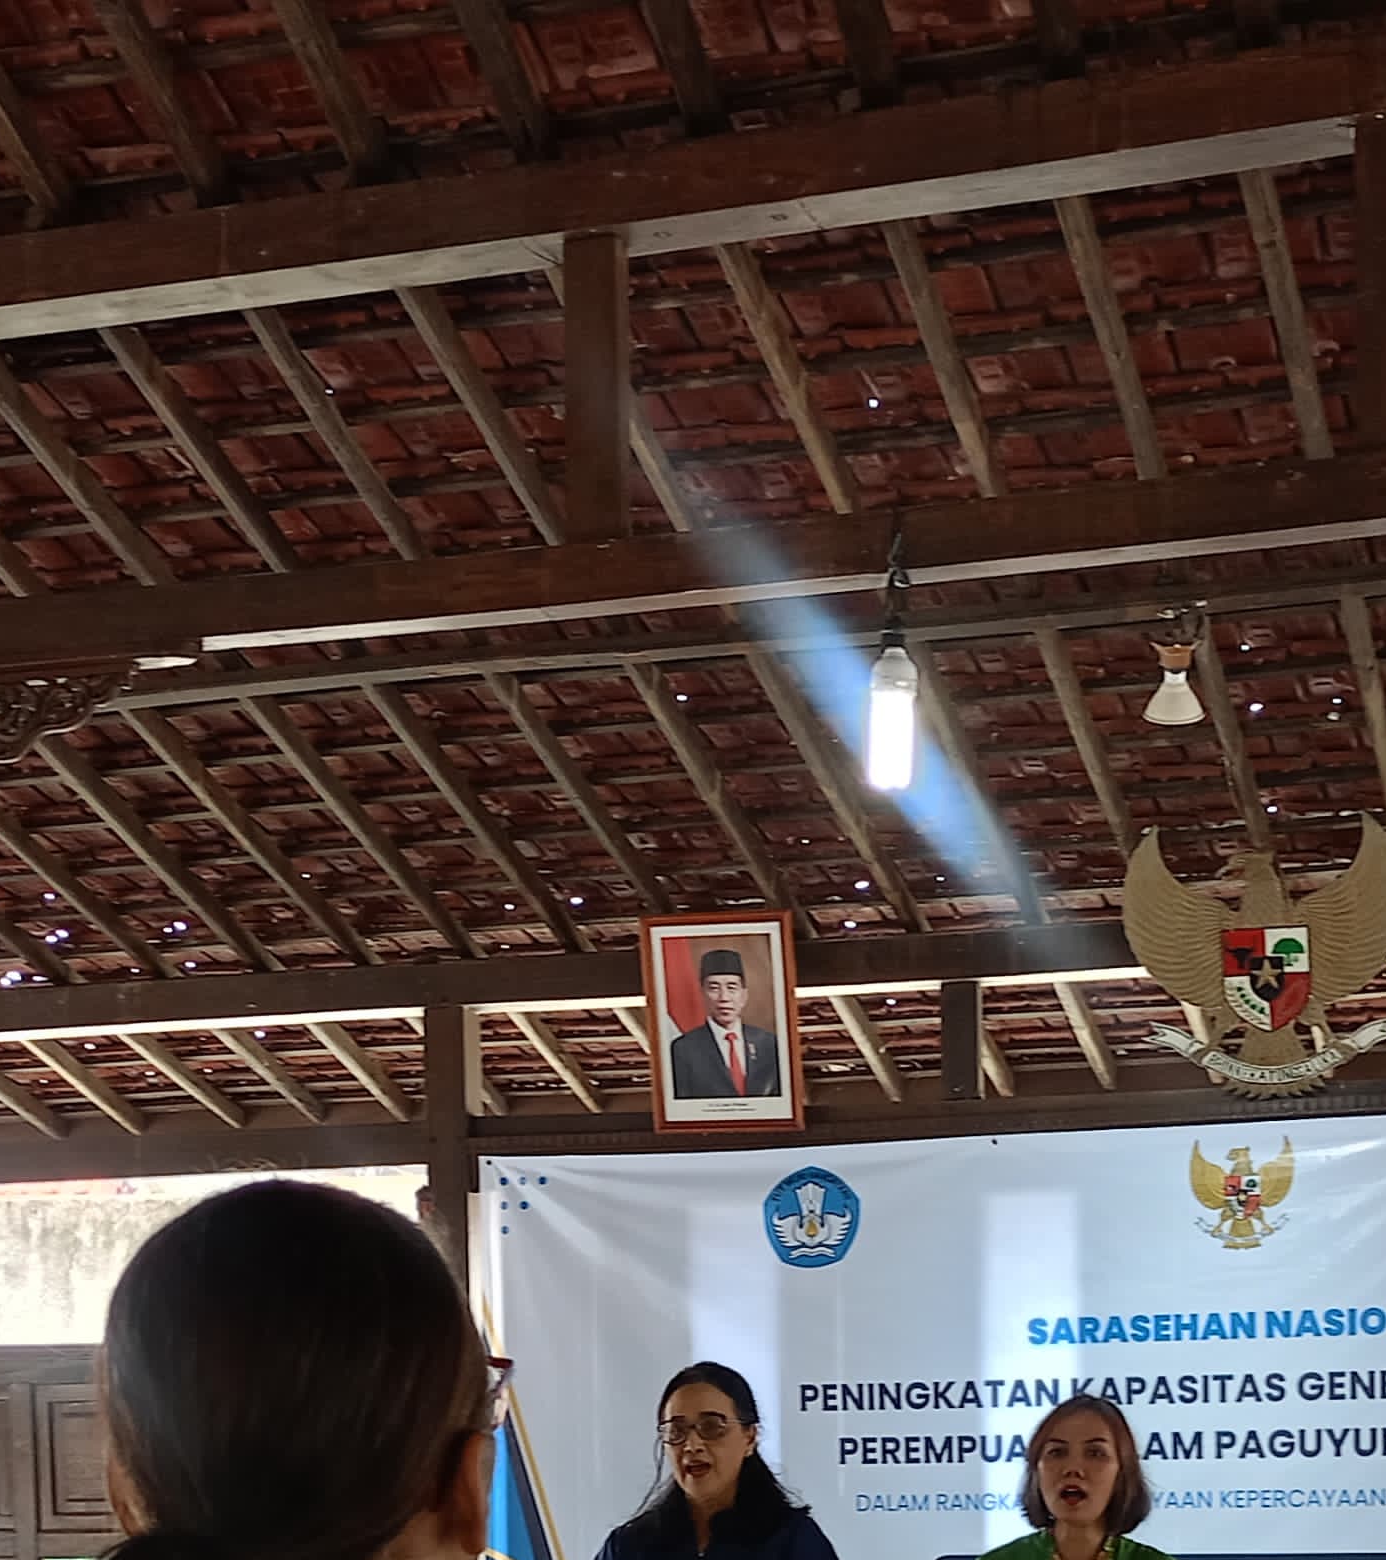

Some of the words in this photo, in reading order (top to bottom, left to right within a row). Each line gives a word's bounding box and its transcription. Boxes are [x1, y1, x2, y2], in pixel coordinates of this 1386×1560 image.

[1027, 1311, 1257, 1345] SARASEHAN
[799, 1379, 1060, 1411] PENINGKATAN
[1071, 1372, 1286, 1405] KAPASITAS
[838, 1434, 1028, 1465] PEREMPUA
[855, 1494, 931, 1512] DALAM
[1220, 1487, 1386, 1509] KEPERCAYAAN
